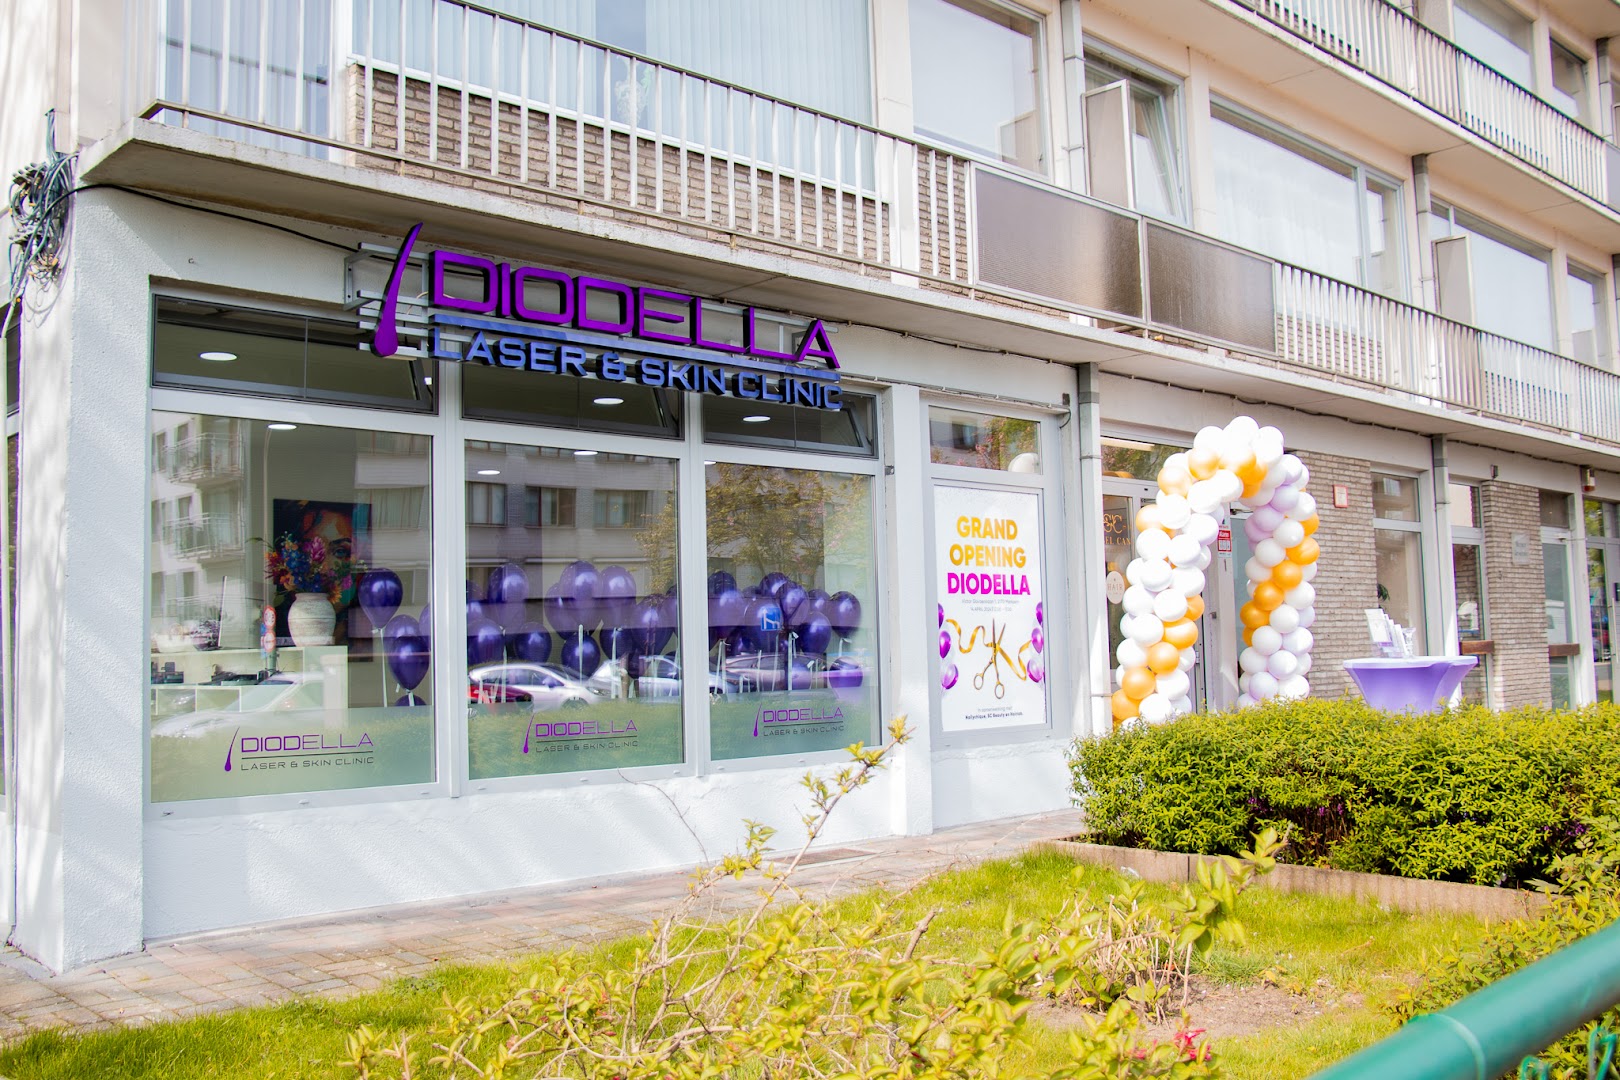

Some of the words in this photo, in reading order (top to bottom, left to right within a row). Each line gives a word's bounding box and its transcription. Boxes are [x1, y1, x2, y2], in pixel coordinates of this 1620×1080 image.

[430, 250, 840, 369] DIODELLA
[429, 326, 587, 377] LASER
[597, 350, 627, 382] &
[636, 357, 726, 396] SKIN
[732, 371, 844, 411] CLINIC
[956, 515, 1018, 541] GRAND
[949, 543, 1027, 569] OPENING
[947, 572, 1031, 596] DIODELLA
[763, 706, 844, 723] DIODELLA
[535, 719, 638, 738] DIODELLA
[763, 728, 791, 737] LASER
[241, 732, 374, 753] DIODELLA
[535, 744, 570, 753] LASER
[583, 742, 605, 750] SKIN
[240, 761, 286, 771] LASER
[290, 760, 298, 768] &
[302, 759, 332, 768] SKIN
[335, 756, 375, 766] CLINIC
